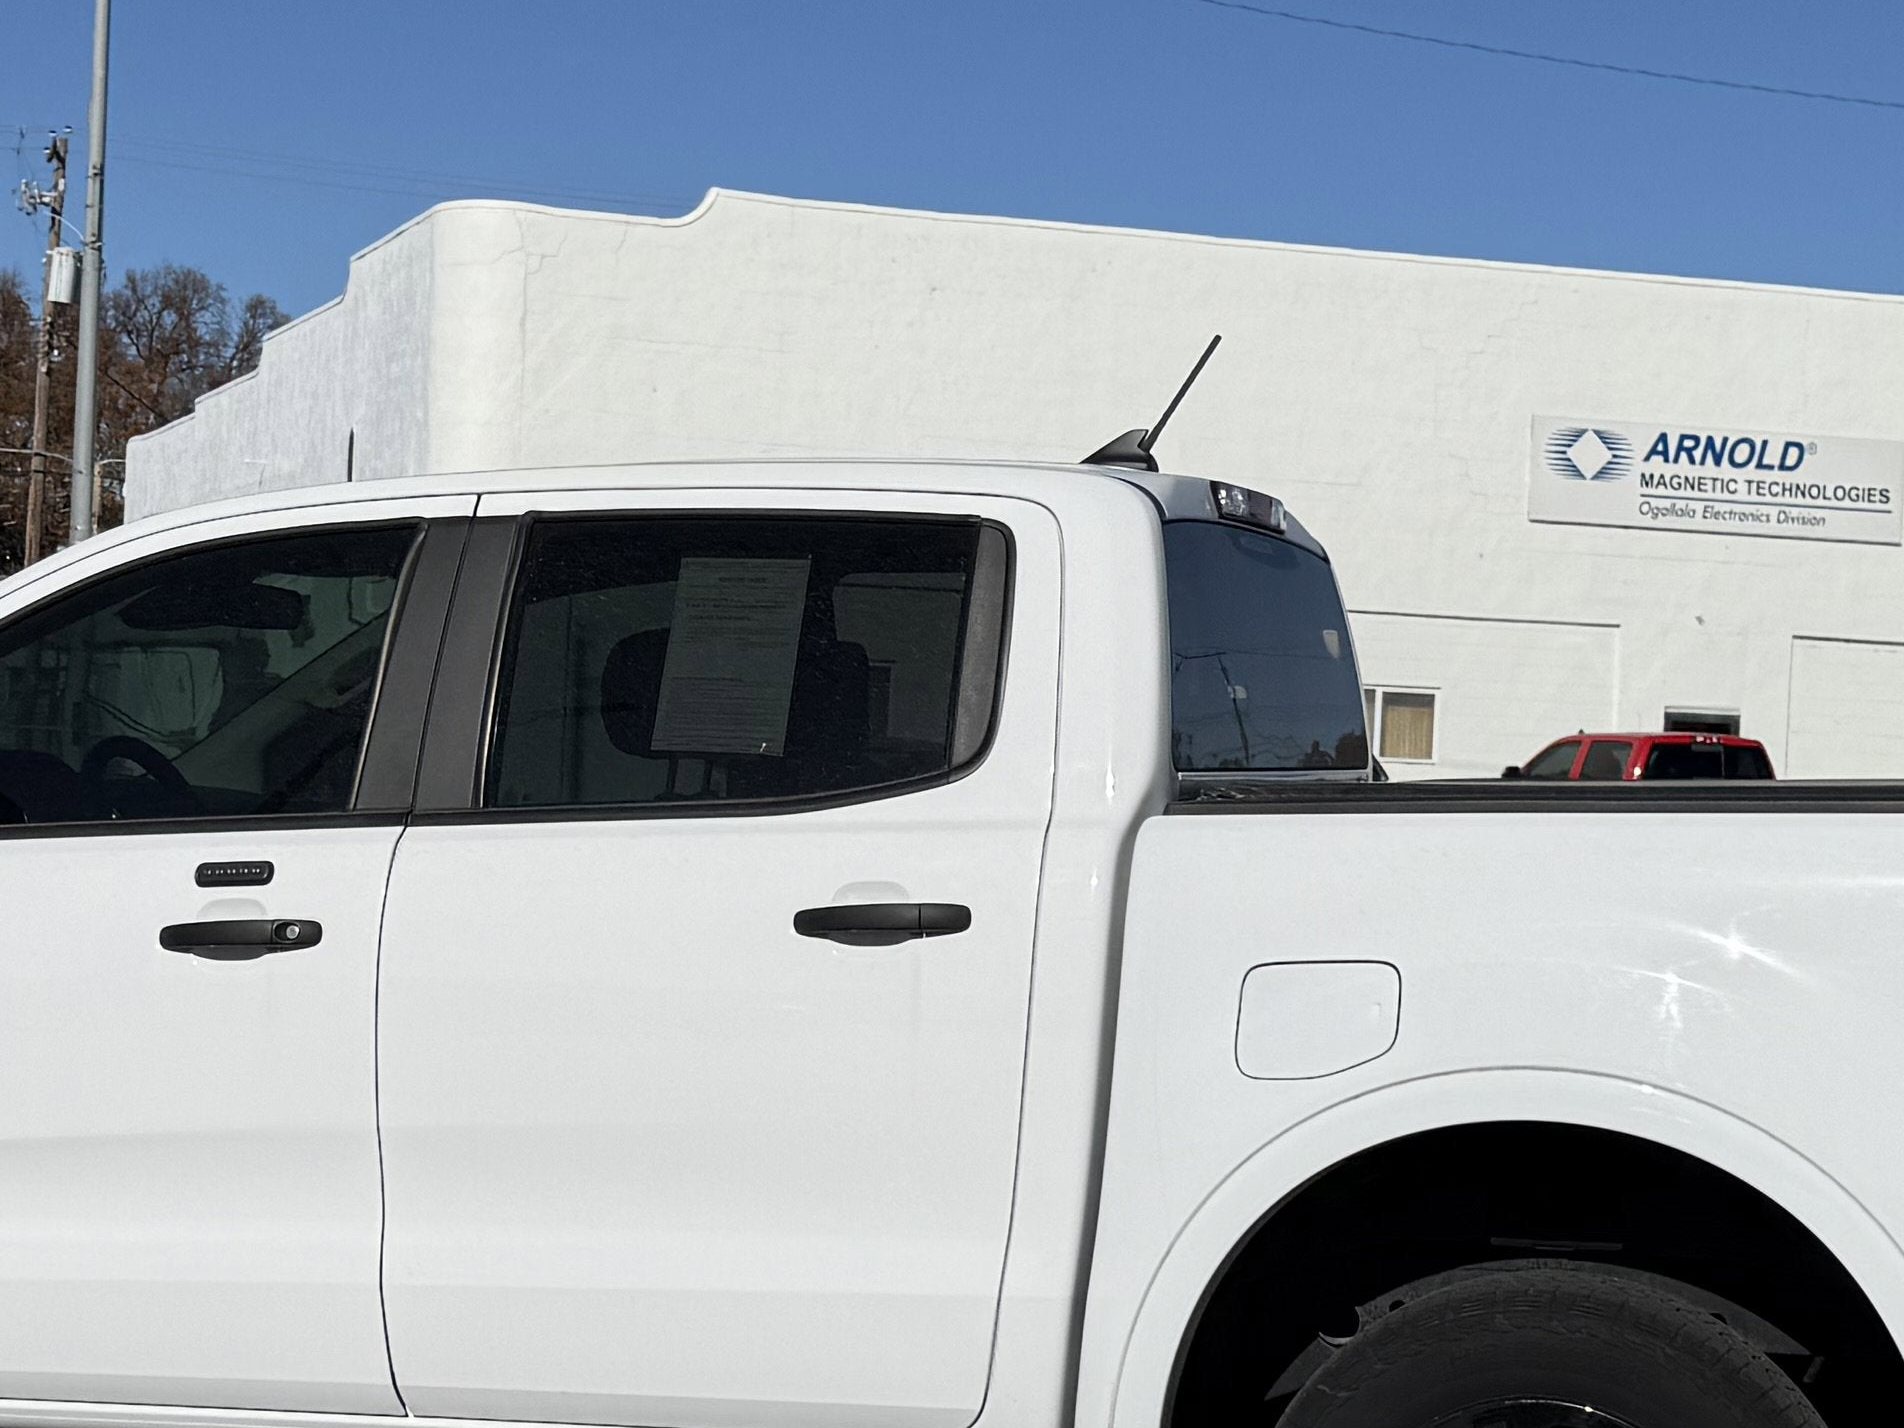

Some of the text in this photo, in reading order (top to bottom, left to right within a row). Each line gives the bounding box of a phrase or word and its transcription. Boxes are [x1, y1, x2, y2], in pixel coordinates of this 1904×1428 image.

[1639, 472, 1892, 505] MAGNETIC TECHNOLOGIES
[1638, 500, 1826, 527] Ogallala Electronics Division
